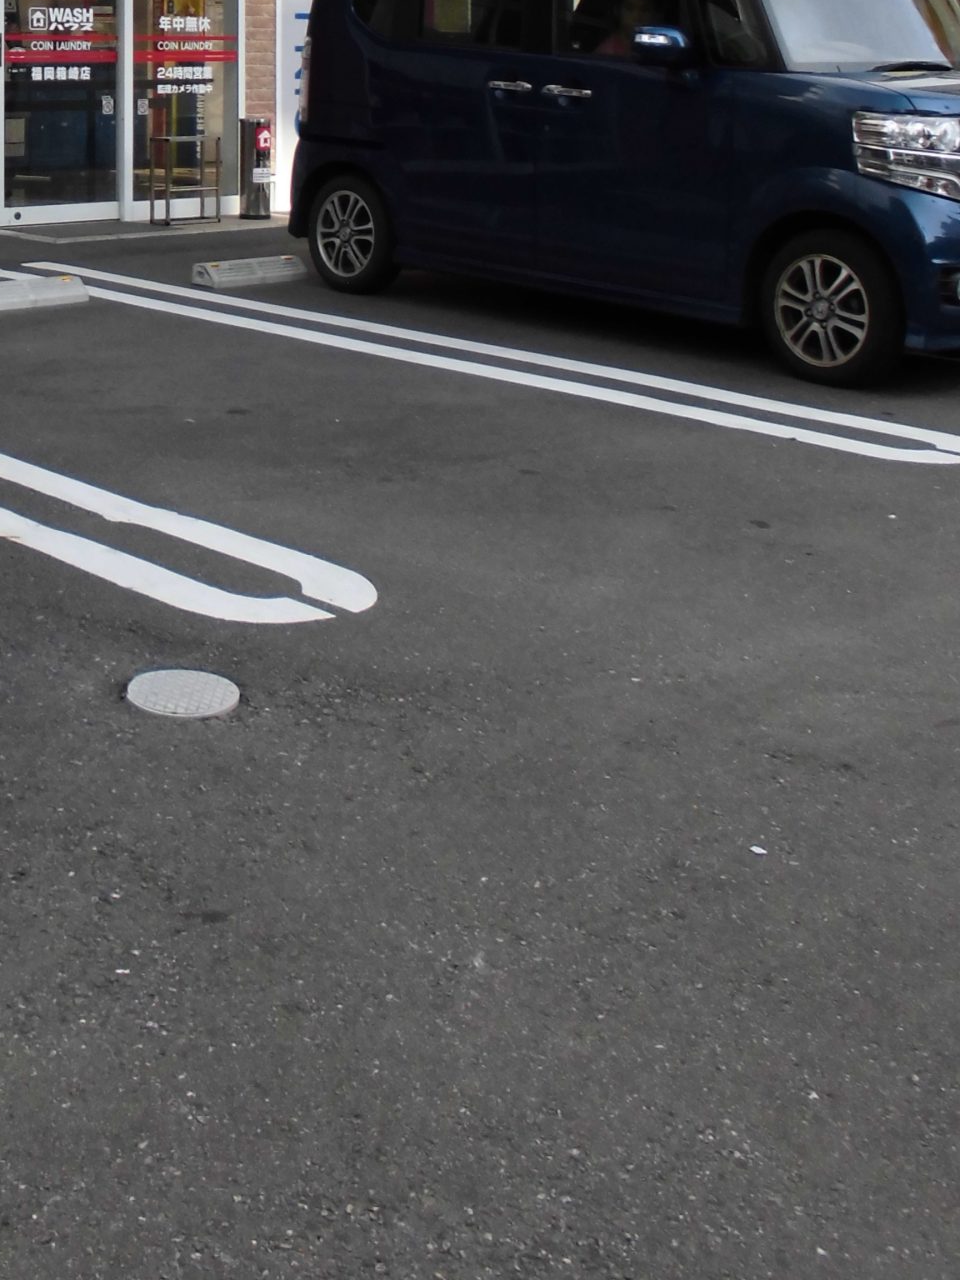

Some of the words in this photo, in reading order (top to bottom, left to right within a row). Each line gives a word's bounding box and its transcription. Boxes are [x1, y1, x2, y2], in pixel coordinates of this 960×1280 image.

[48, 7, 94, 22] WASH
[48, 22, 94, 32] ハウス
[159, 15, 211, 32] 年中無休
[31, 41, 54, 51] COIN
[55, 41, 92, 51] LAUNDRY
[157, 41, 178, 51] COIN
[157, 66, 212, 79] 24時間営業
